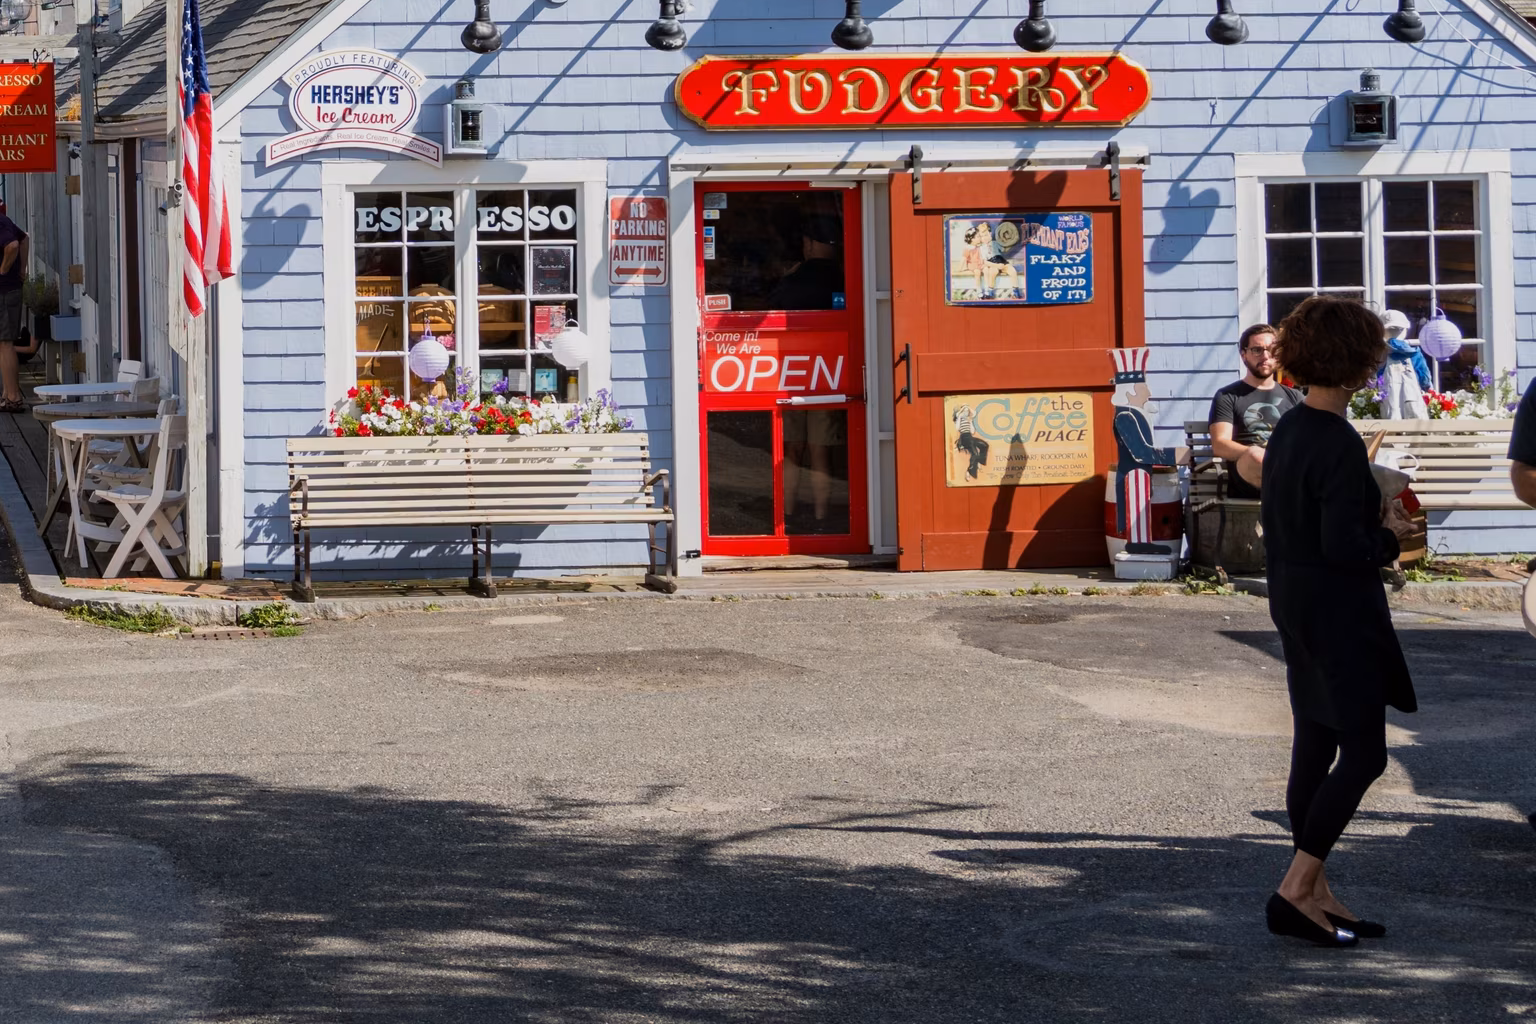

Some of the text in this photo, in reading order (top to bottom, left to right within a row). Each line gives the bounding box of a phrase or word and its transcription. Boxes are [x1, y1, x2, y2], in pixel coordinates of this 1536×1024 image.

[295, 53, 417, 84] PROUDLY FEATURING
[311, 85, 400, 105] HERSHEY'S
[721, 65, 1111, 116] FUDGERY
[316, 106, 396, 124] Ice Cream
[279, 140, 296, 150] Real
[337, 132, 353, 140] Real
[354, 132, 364, 140] Ice
[392, 136, 408, 146] Real
[630, 202, 648, 218] NO
[1058, 214, 1084, 222] WORLD
[612, 219, 666, 236] PARKING
[1066, 228, 1089, 254] EARS
[613, 245, 664, 261] ANYTIME
[1030, 254, 1086, 265] FLAKY
[1052, 266, 1086, 276] AND
[1041, 278, 1086, 288] PROUD
[379, 286, 393, 297] IT
[1043, 289, 1087, 300] OF IT!
[356, 303, 395, 325] MADE
[705, 330, 758, 342] Come in!
[716, 343, 761, 354] We Are
[711, 355, 844, 392] OPEN
[1051, 395, 1084, 410] the
[972, 396, 1087, 445] Coffee
[1034, 429, 1088, 443] PLACE
[995, 454, 1014, 462] TUNA
[1015, 453, 1039, 462] WHARF,
